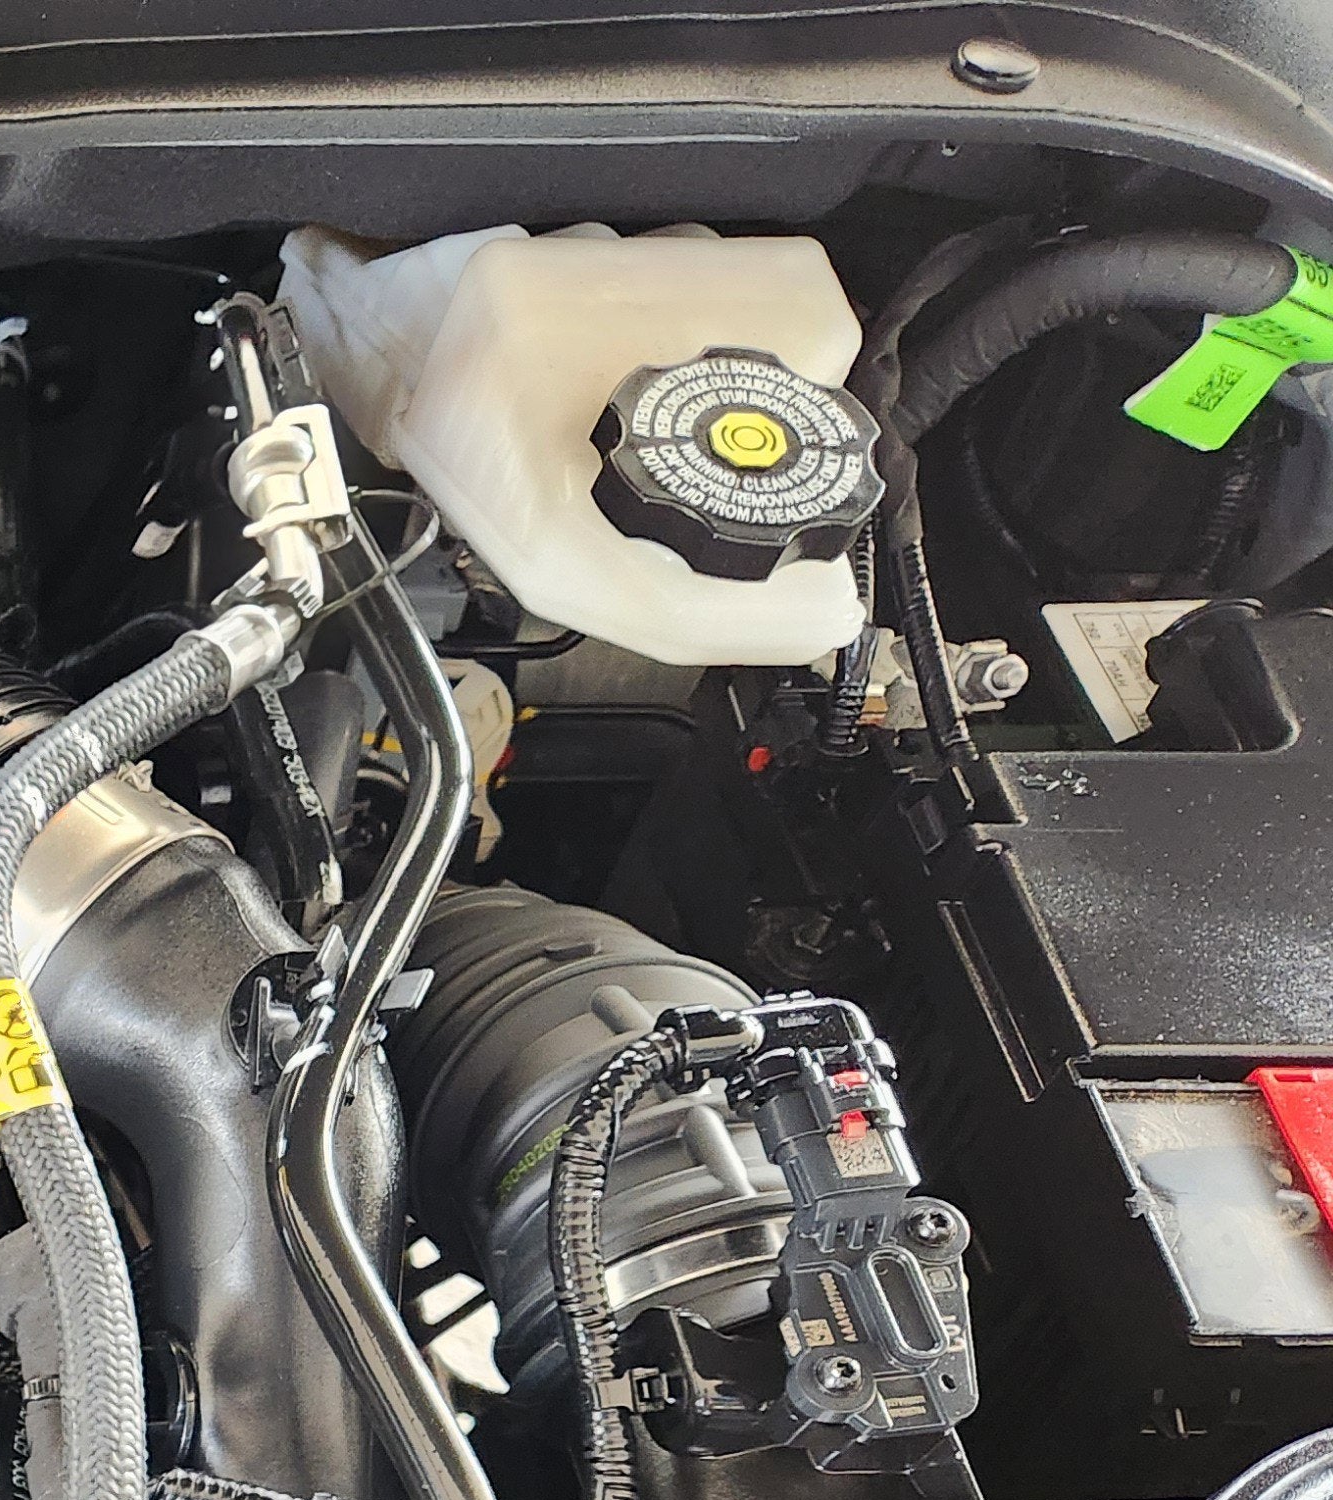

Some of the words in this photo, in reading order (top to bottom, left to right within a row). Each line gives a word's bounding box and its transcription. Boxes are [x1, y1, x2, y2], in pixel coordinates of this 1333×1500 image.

[711, 360, 730, 375] LE
[729, 359, 791, 386] BOUCHON
[788, 377, 832, 406] AVANT
[727, 374, 778, 396] LIQUIDE
[774, 384, 795, 402] DE
[748, 390, 788, 416] BIDON
[658, 444, 686, 468] CAP
[676, 464, 732, 502] BEFORE
[661, 474, 706, 506] FLUID
[703, 496, 751, 522] FROM
[751, 506, 765, 524] A
[764, 500, 823, 524] SEALED
[819, 451, 863, 511] CONTAINER
[742, 473, 793, 493] CLEAN
[786, 447, 821, 485] FILLER
